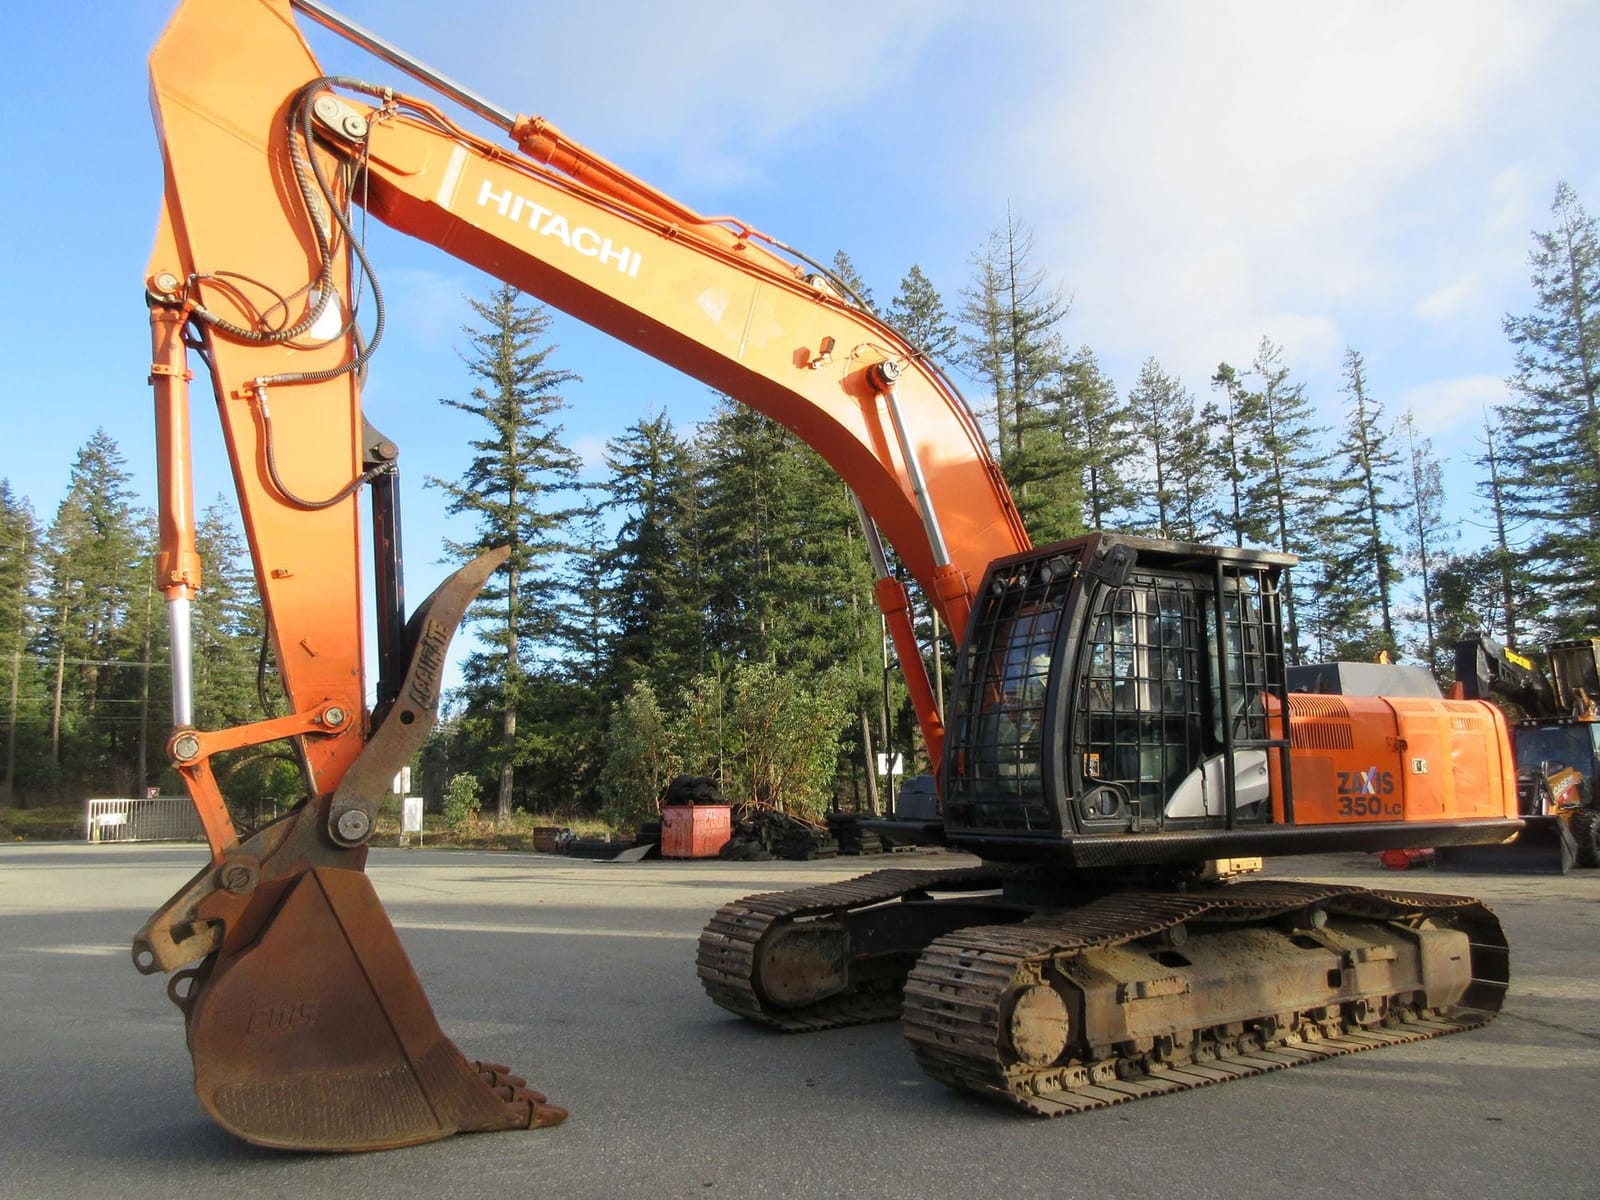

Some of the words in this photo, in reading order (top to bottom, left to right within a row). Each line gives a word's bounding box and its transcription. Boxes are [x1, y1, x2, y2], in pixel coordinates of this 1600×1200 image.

[477, 180, 642, 278] HITACHI
[1337, 767, 1394, 795] ZAXIS
[1338, 797, 1382, 816] 350
[1384, 803, 1402, 815] LC
